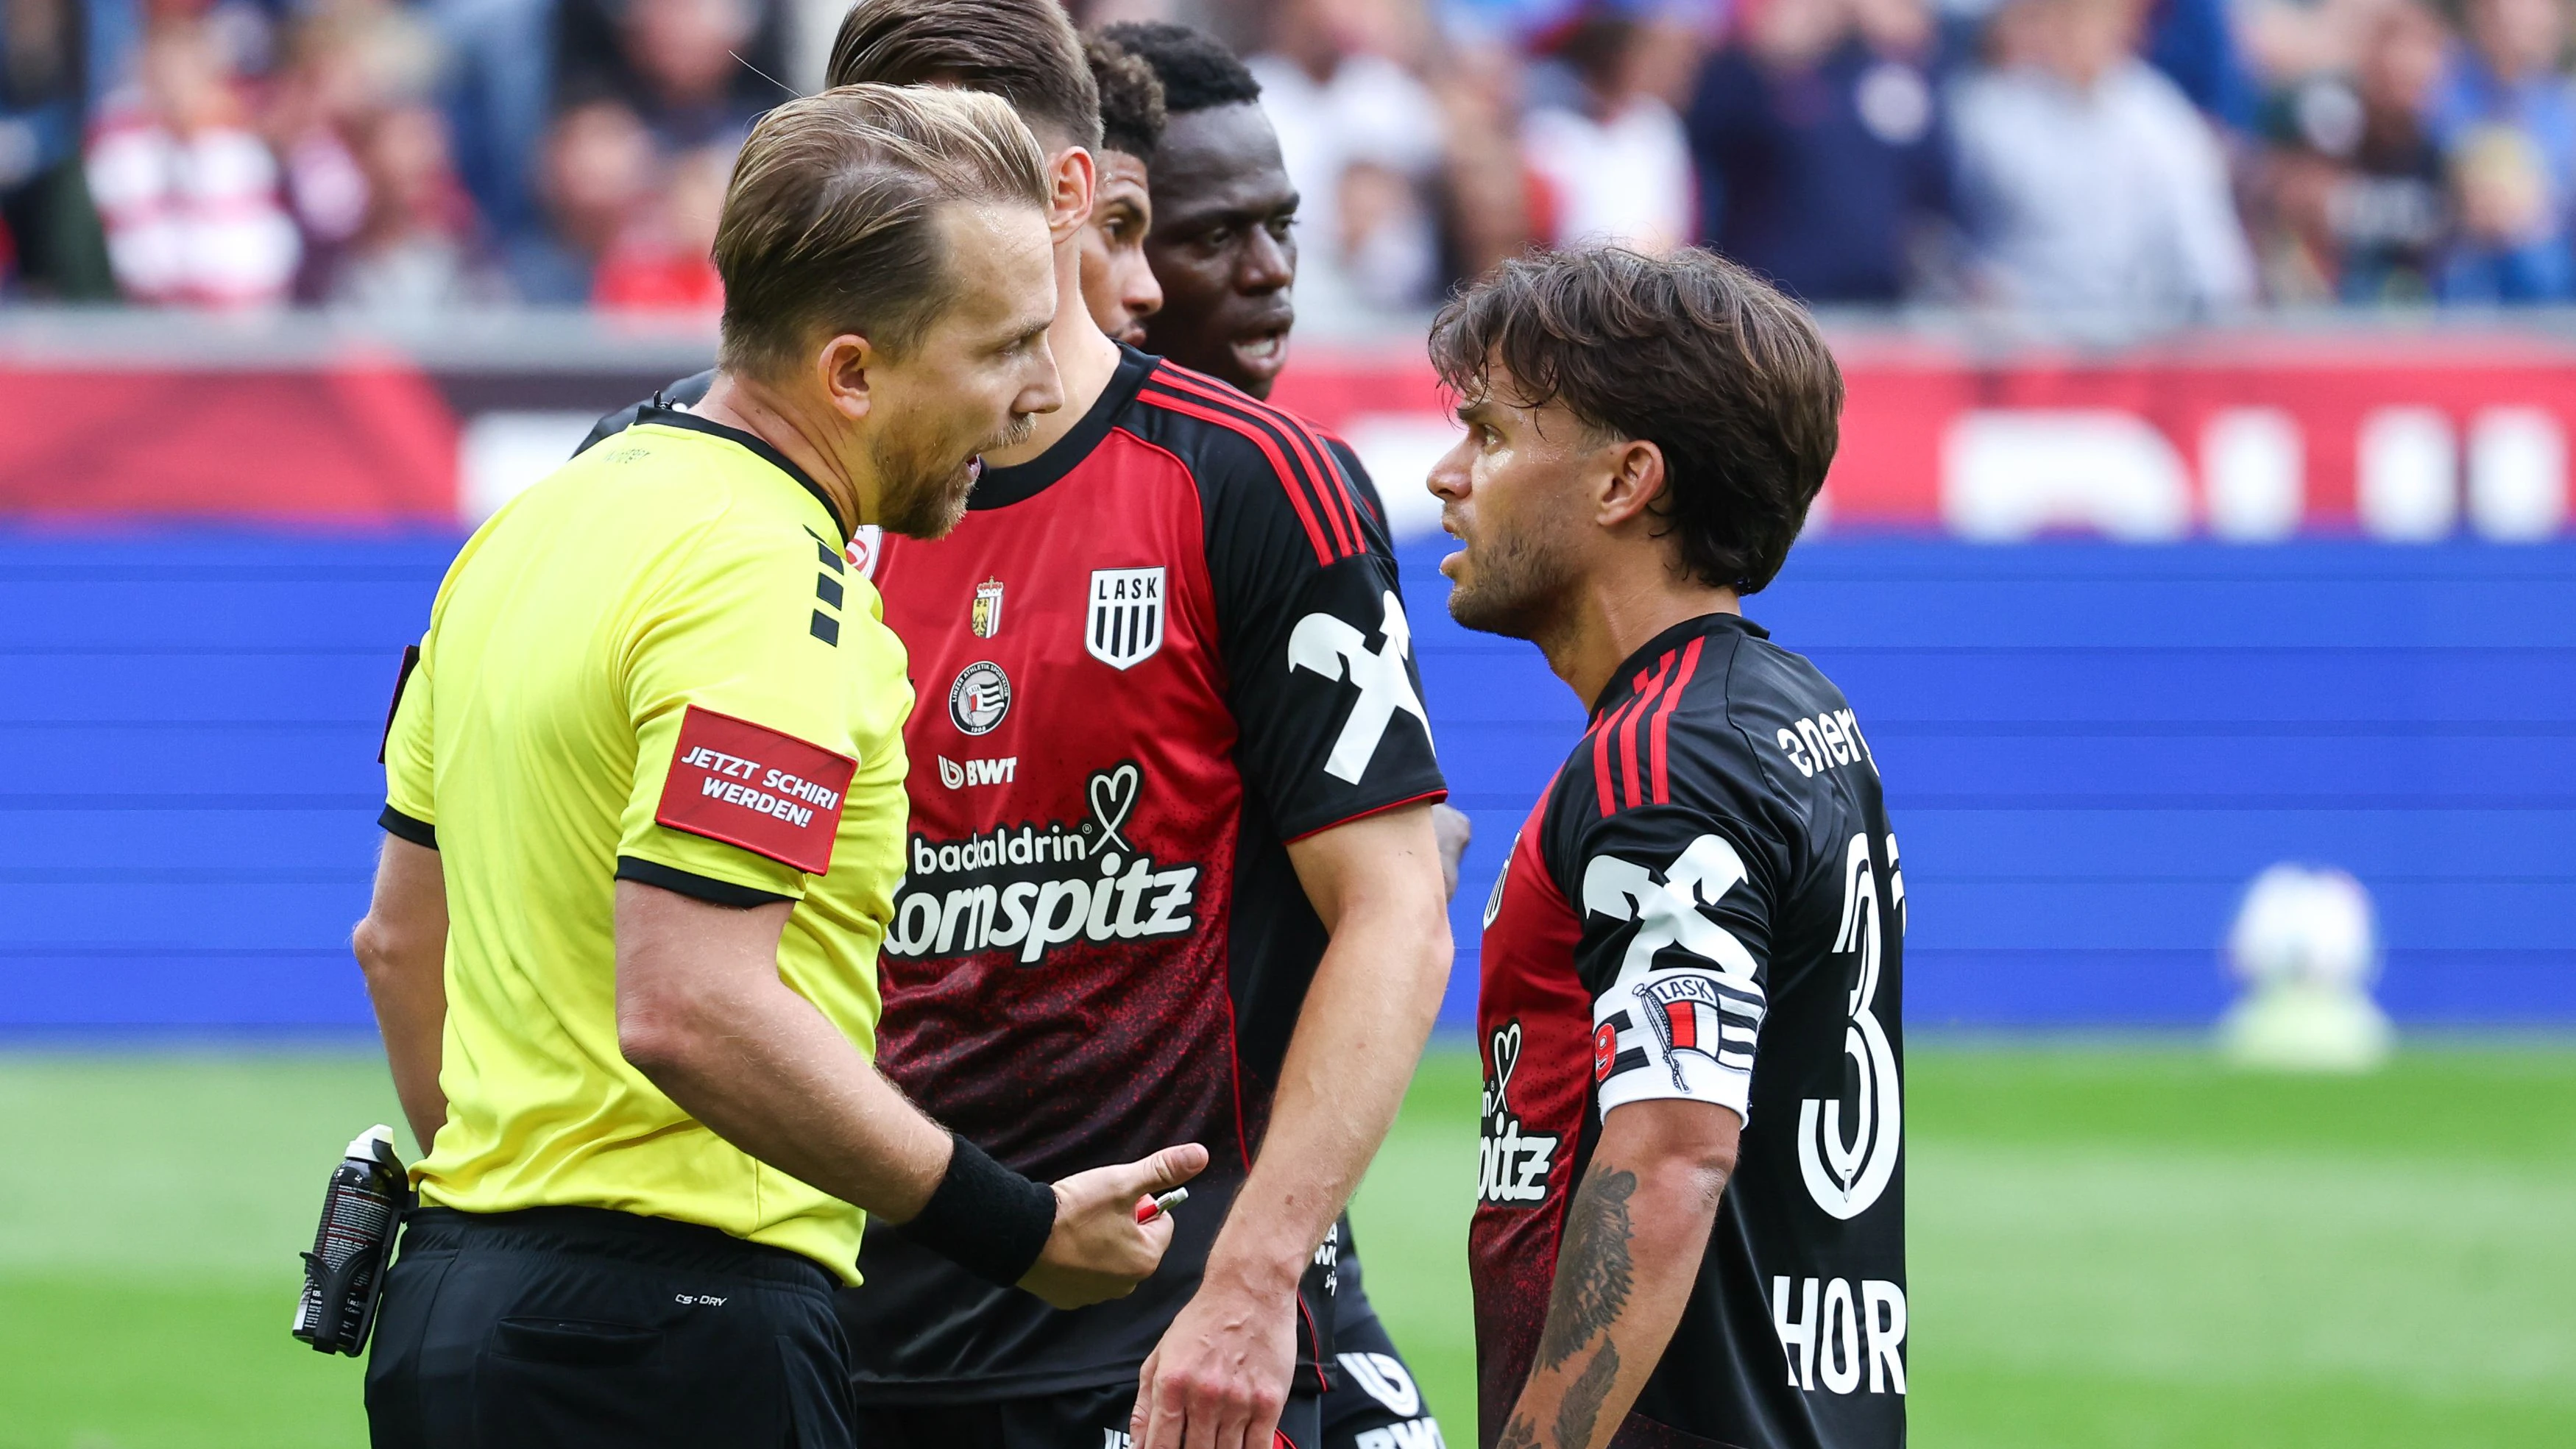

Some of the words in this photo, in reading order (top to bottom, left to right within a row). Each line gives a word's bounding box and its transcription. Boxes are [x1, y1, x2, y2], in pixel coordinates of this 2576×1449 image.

[1098, 576, 1158, 600] LASK
[952, 677, 965, 703] LINZER
[963, 664, 990, 679] ATHLETIK
[1777, 707, 1880, 778] ener
[681, 746, 761, 780] JETZT
[762, 768, 839, 810] SCHIRI
[965, 756, 1017, 787] BWT
[701, 776, 813, 829] WERDEN!
[882, 851, 1197, 963] ornspitz
[1657, 979, 1714, 1002] LASK
